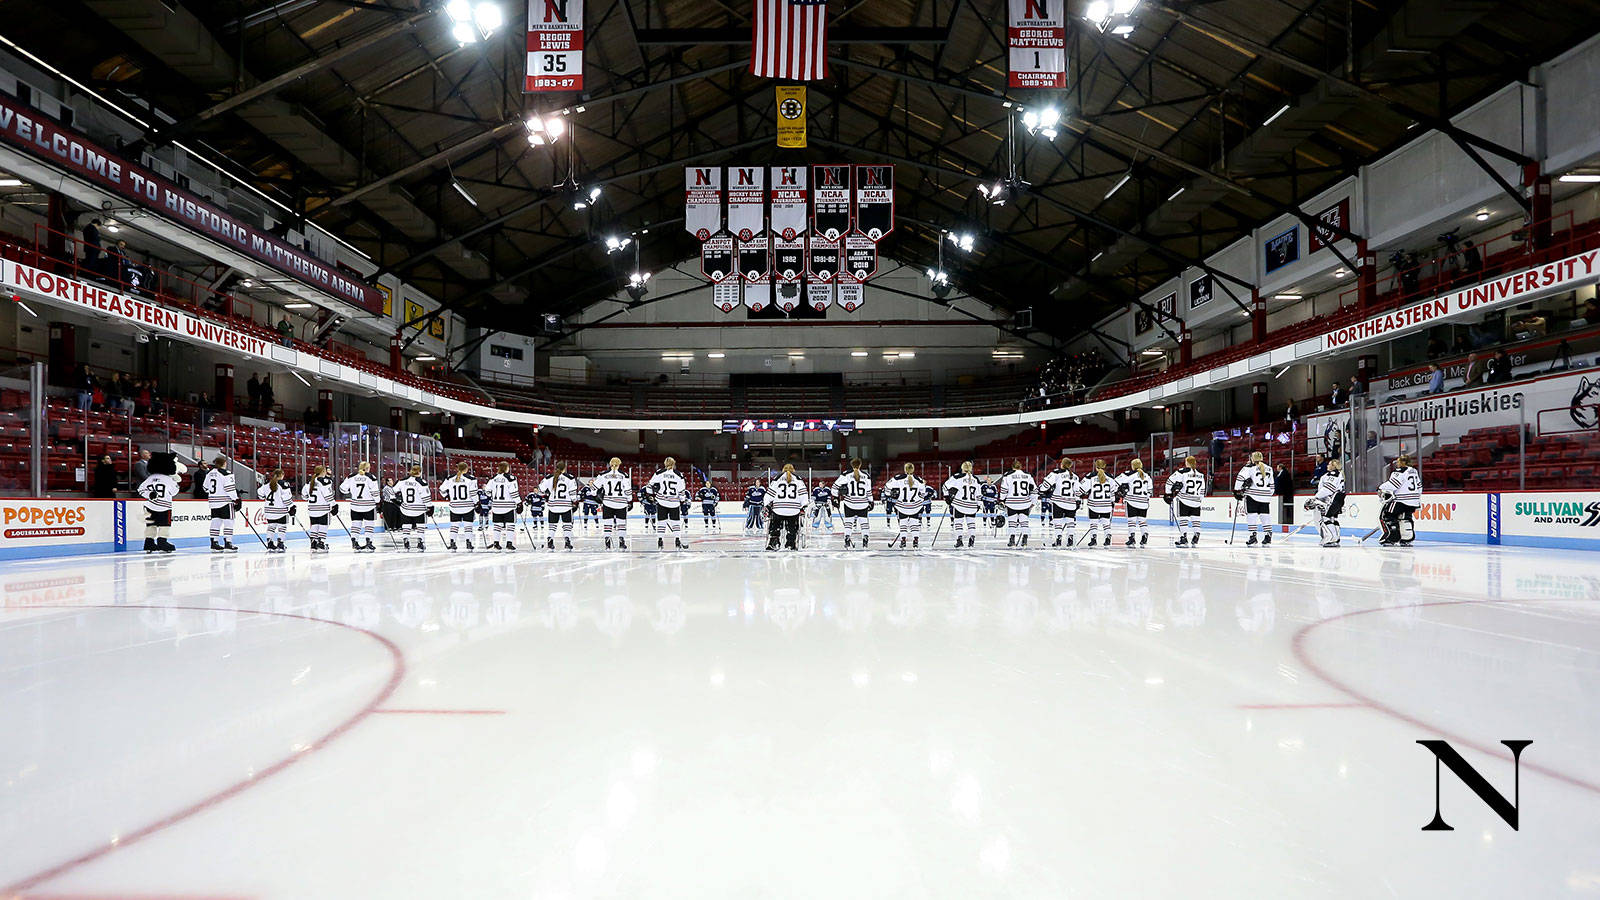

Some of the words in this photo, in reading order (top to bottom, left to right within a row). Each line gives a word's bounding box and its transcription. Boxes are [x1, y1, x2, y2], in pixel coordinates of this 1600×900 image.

[540, 33, 571, 41] REGGIE
[1019, 29, 1053, 38] GEORGE
[540, 41, 570, 49] LEWIS
[1010, 38, 1063, 47] MATTHEWS
[543, 54, 567, 72] 35
[1034, 51, 1040, 69] 1
[696, 168, 711, 186] N
[738, 168, 754, 186] N
[824, 168, 840, 186] N
[866, 168, 883, 186] N
[130, 171, 157, 201] TO
[165, 189, 247, 246] HISTORIC
[252, 234, 329, 285] MATTHEWS
[332, 275, 365, 302] ARENA
[853, 261, 869, 269] 2018
[1327, 297, 1448, 348] NORTHEASTERN
[1458, 251, 1598, 310] UNIVERSITY
[15, 264, 178, 330] NORTHEASTERN
[186, 318, 266, 355] UNIVERSITY
[1390, 376, 1411, 389] Jack
[210, 479, 217, 494] 3
[356, 483, 365, 499] 7
[453, 484, 468, 500] 10
[494, 484, 505, 500] 11
[607, 480, 623, 496] 14
[663, 480, 678, 495] 15
[778, 483, 797, 499] 33
[850, 481, 866, 496] 16
[962, 485, 976, 501] 18
[1012, 480, 1029, 497] 19
[1186, 480, 1202, 495] 27
[406, 488, 415, 503] 8
[902, 487, 918, 503] 17
[1515, 502, 1584, 517] SULLIVAN
